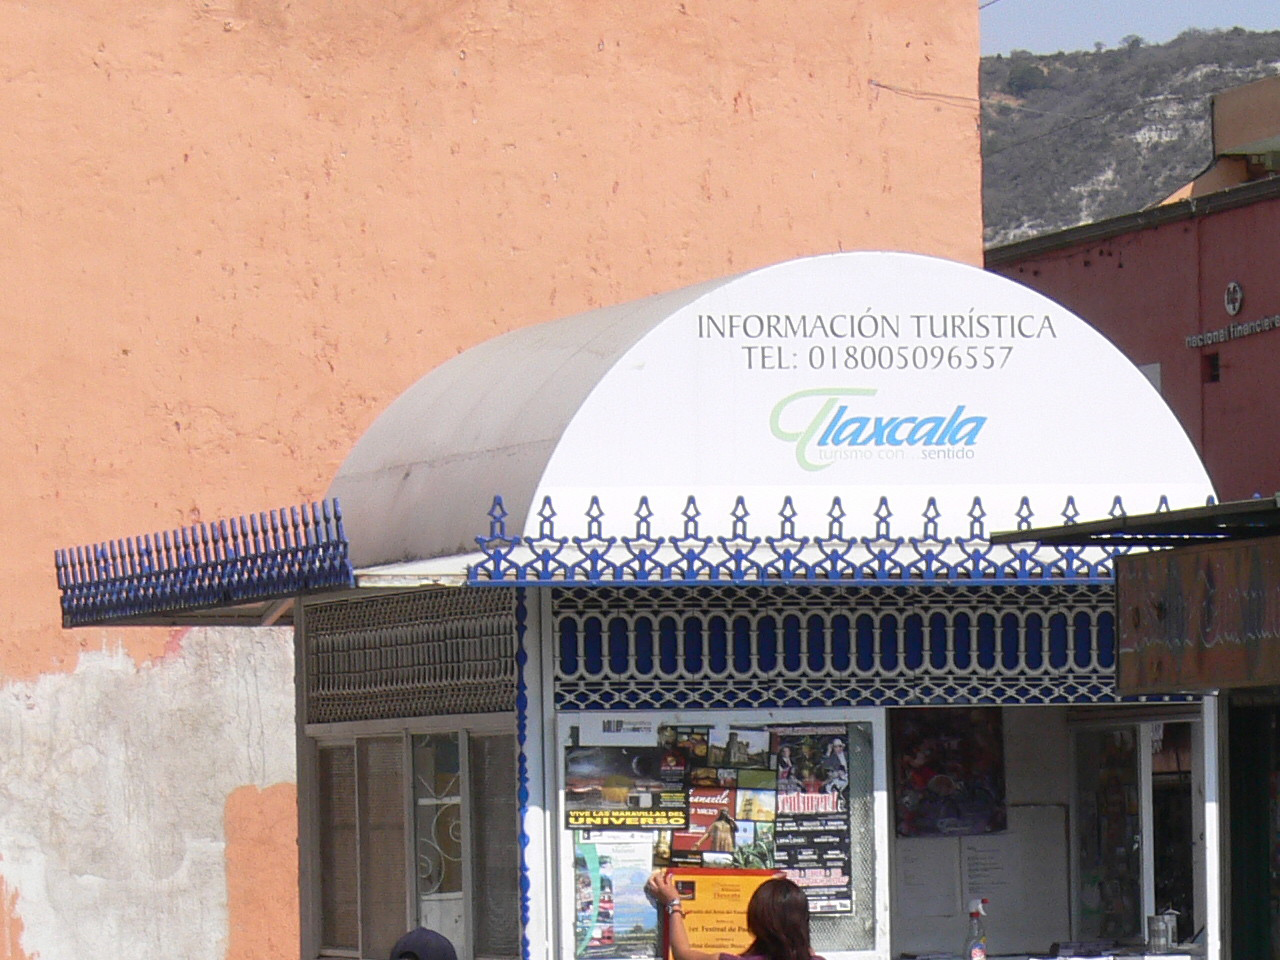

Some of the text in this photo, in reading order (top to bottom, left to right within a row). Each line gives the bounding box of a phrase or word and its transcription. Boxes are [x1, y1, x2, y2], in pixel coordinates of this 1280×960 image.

[697, 307, 1058, 339] INFORMACIÓN TURÍSTICA
[741, 346, 1014, 369] TEL: 018005096557
[769, 387, 988, 472] Tlaxcala
[921, 447, 975, 460] sentido
[568, 817, 686, 826] UNIVERSO
